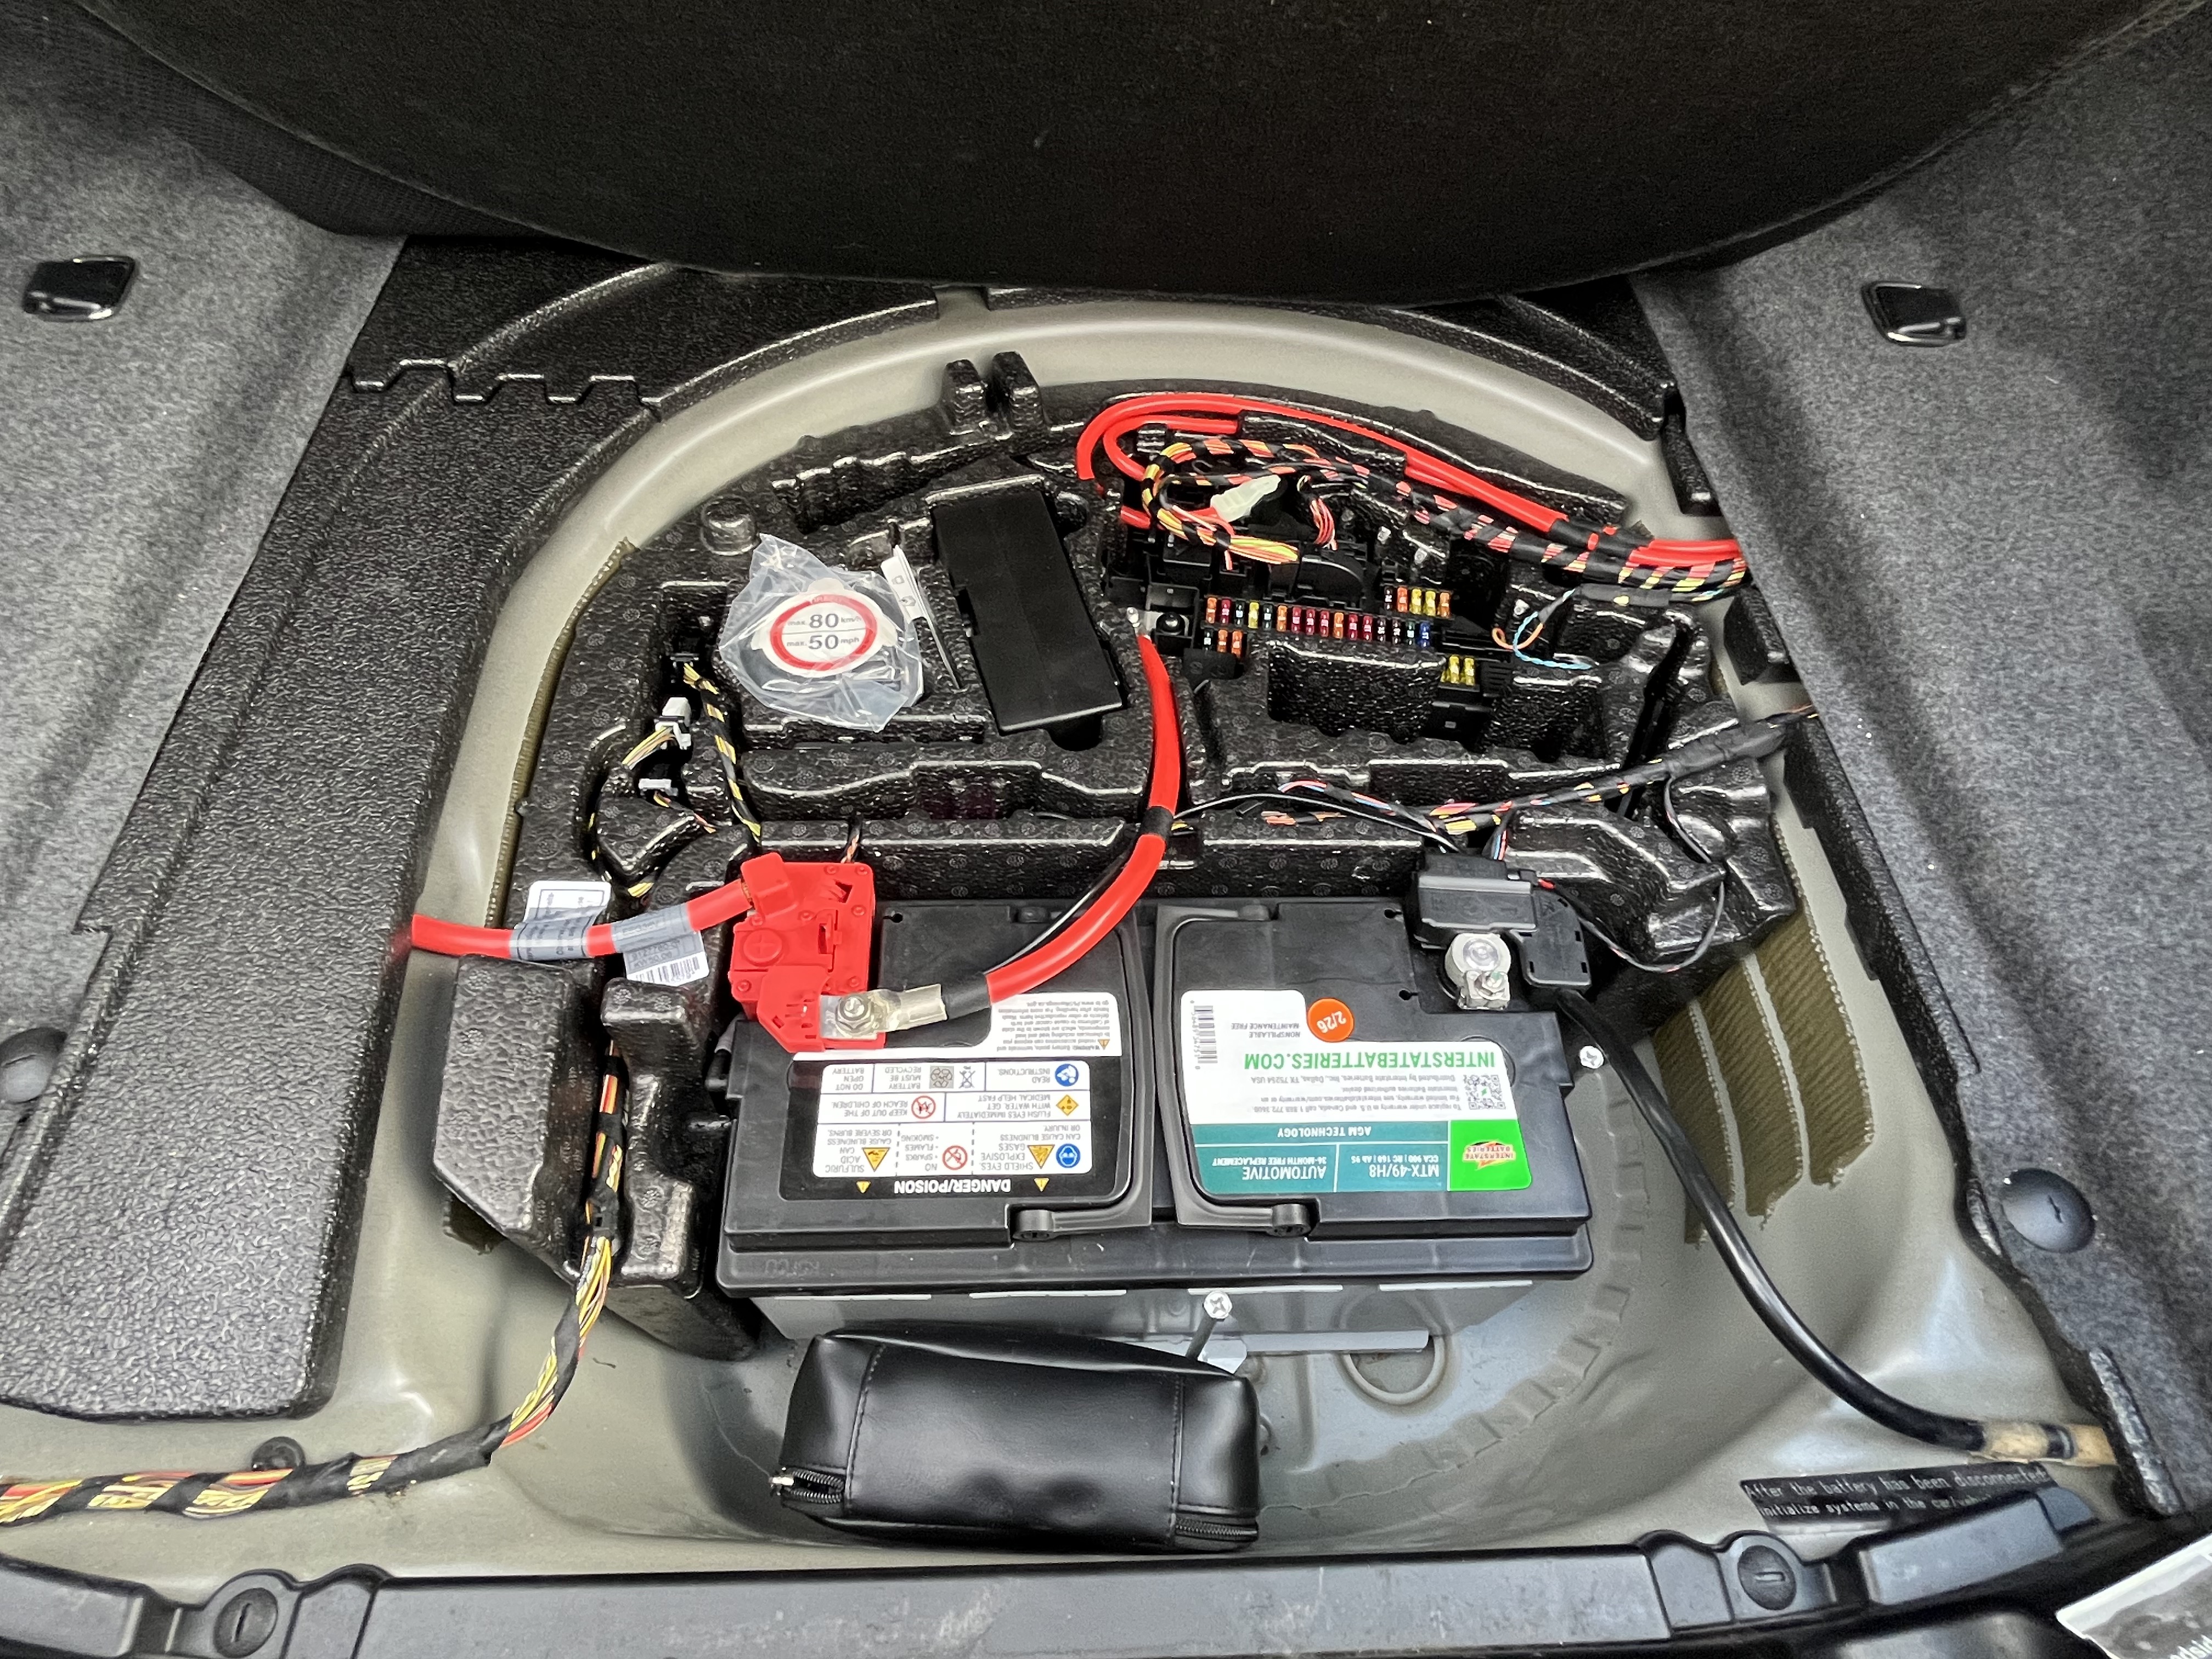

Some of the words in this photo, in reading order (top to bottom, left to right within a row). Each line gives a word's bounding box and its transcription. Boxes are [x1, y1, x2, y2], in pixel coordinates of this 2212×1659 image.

[809, 613, 839, 628] 80
[808, 635, 839, 650] 50
[1316, 1010, 1347, 1034] 2/26
[1244, 1051, 1495, 1069] INTERSTATEBATTERIES.COM
[1409, 1074, 1417, 1082] by
[1277, 1126, 1346, 1138] TECHNOLOGY
[1347, 1126, 1372, 1137] AGM
[981, 1153, 1025, 1161] EXPLOSIVE
[1212, 1156, 1267, 1166] REPLACEMENT
[1268, 1156, 1286, 1165] FREE
[1288, 1156, 1327, 1165] 36-MONTH
[1351, 1155, 1361, 1164] 95
[1362, 1155, 1372, 1163] Ah
[1378, 1155, 1391, 1163] 160
[1392, 1155, 1403, 1163] RC
[1408, 1154, 1422, 1163] 900
[1423, 1154, 1438, 1163] CCA
[925, 1163, 938, 1171] NO
[979, 1162, 1002, 1171] EYES.
[1005, 1162, 1034, 1171] SHIELD
[1369, 1164, 1440, 1177] MTX-49/H8
[1242, 1166, 1327, 1180] AUTOMOTIVE
[894, 1178, 1011, 1193] DANGER/POISON
[1744, 1482, 1783, 1498] After
[1789, 1481, 1818, 1496] the
[1818, 1476, 1877, 1496] battery
[1878, 1475, 1910, 1491] has
[1910, 1474, 1951, 1490] been
[1758, 1503, 1820, 1516] initialize
[1825, 1500, 1879, 1515] systems
[1901, 1497, 1926, 1509] the
